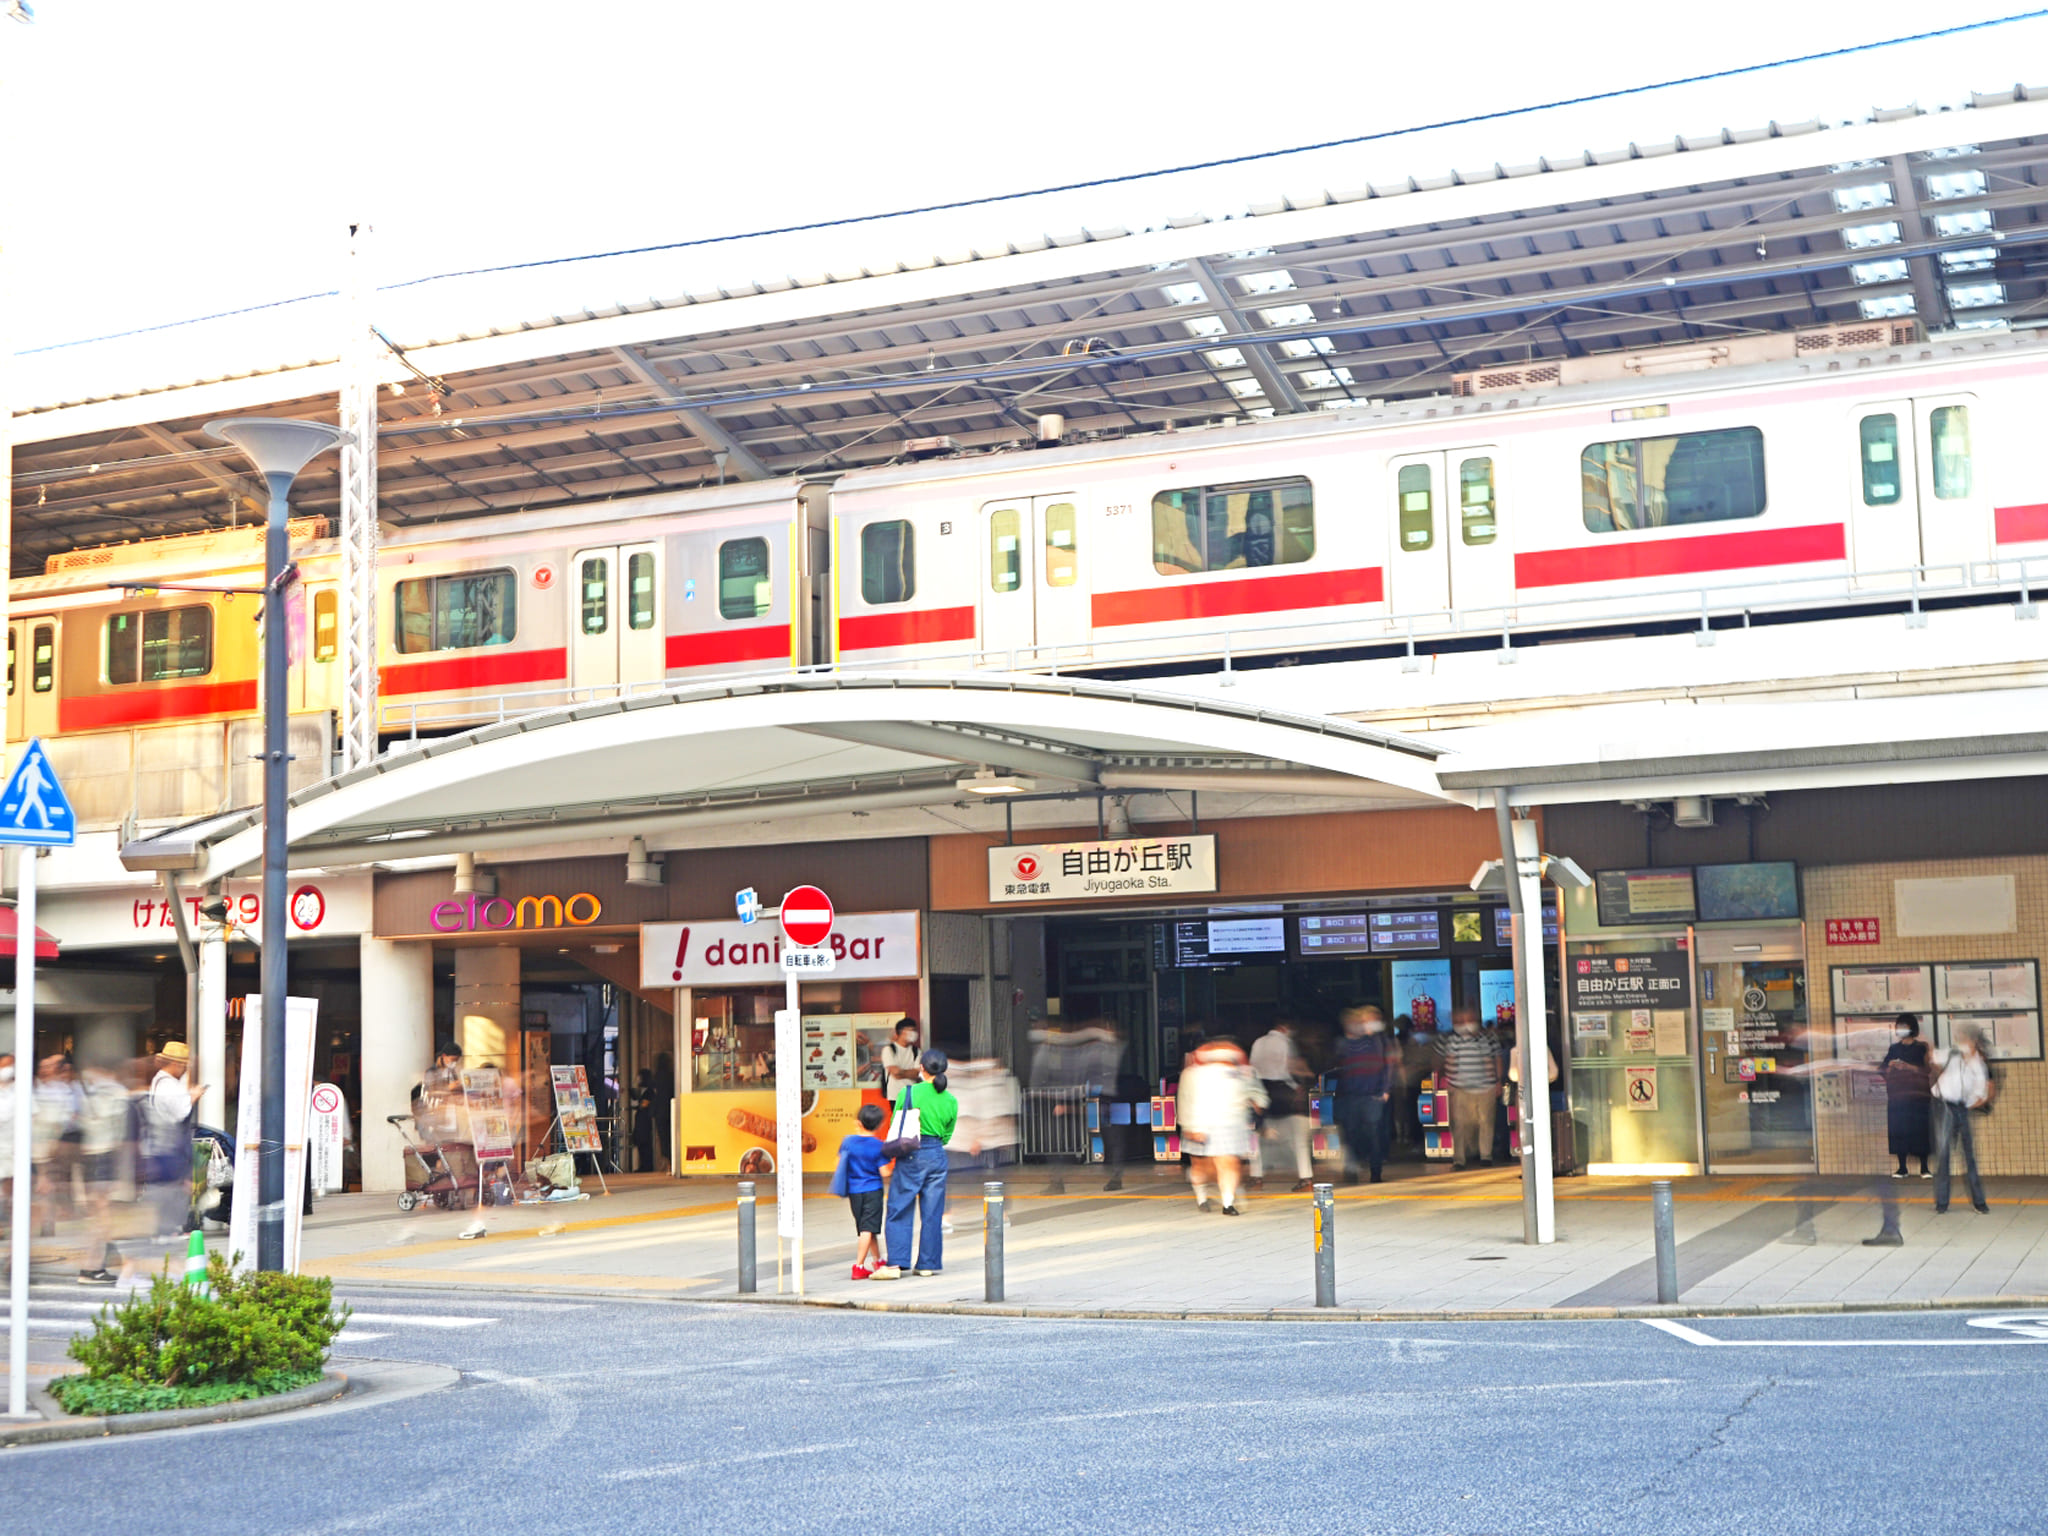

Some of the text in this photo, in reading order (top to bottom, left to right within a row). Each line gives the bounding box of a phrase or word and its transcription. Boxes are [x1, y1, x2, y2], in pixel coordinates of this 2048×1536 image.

[1105, 504, 1132, 517] 5371
[941, 522, 951, 535] 3
[1062, 843, 1192, 877] 自由が丘駅
[1004, 882, 1051, 896] 東急電鉄
[1148, 875, 1172, 889] Sta.
[430, 892, 602, 932] etomo
[831, 933, 885, 961] Bar
[1577, 976, 1681, 992] 自由が丘駅 正面口
